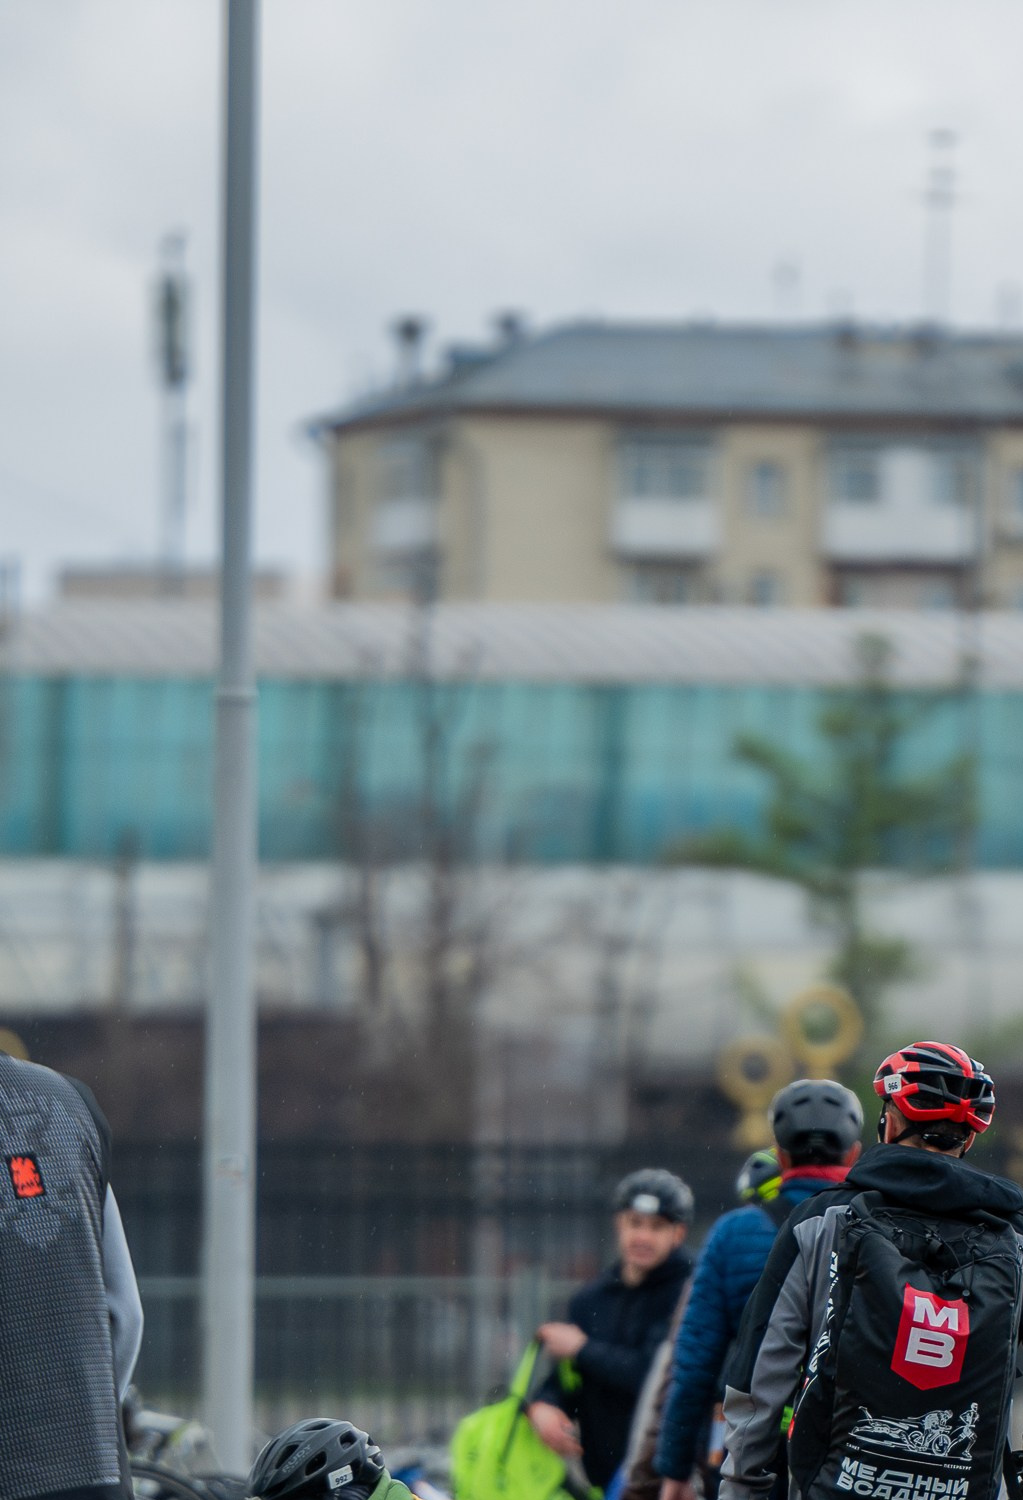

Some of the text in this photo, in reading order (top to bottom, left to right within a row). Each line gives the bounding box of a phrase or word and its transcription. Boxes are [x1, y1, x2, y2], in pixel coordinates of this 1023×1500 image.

[888, 1082, 898, 1091] 966
[335, 1474, 348, 1485] 992
[841, 1456, 969, 1496] МЕДНЫЙ
